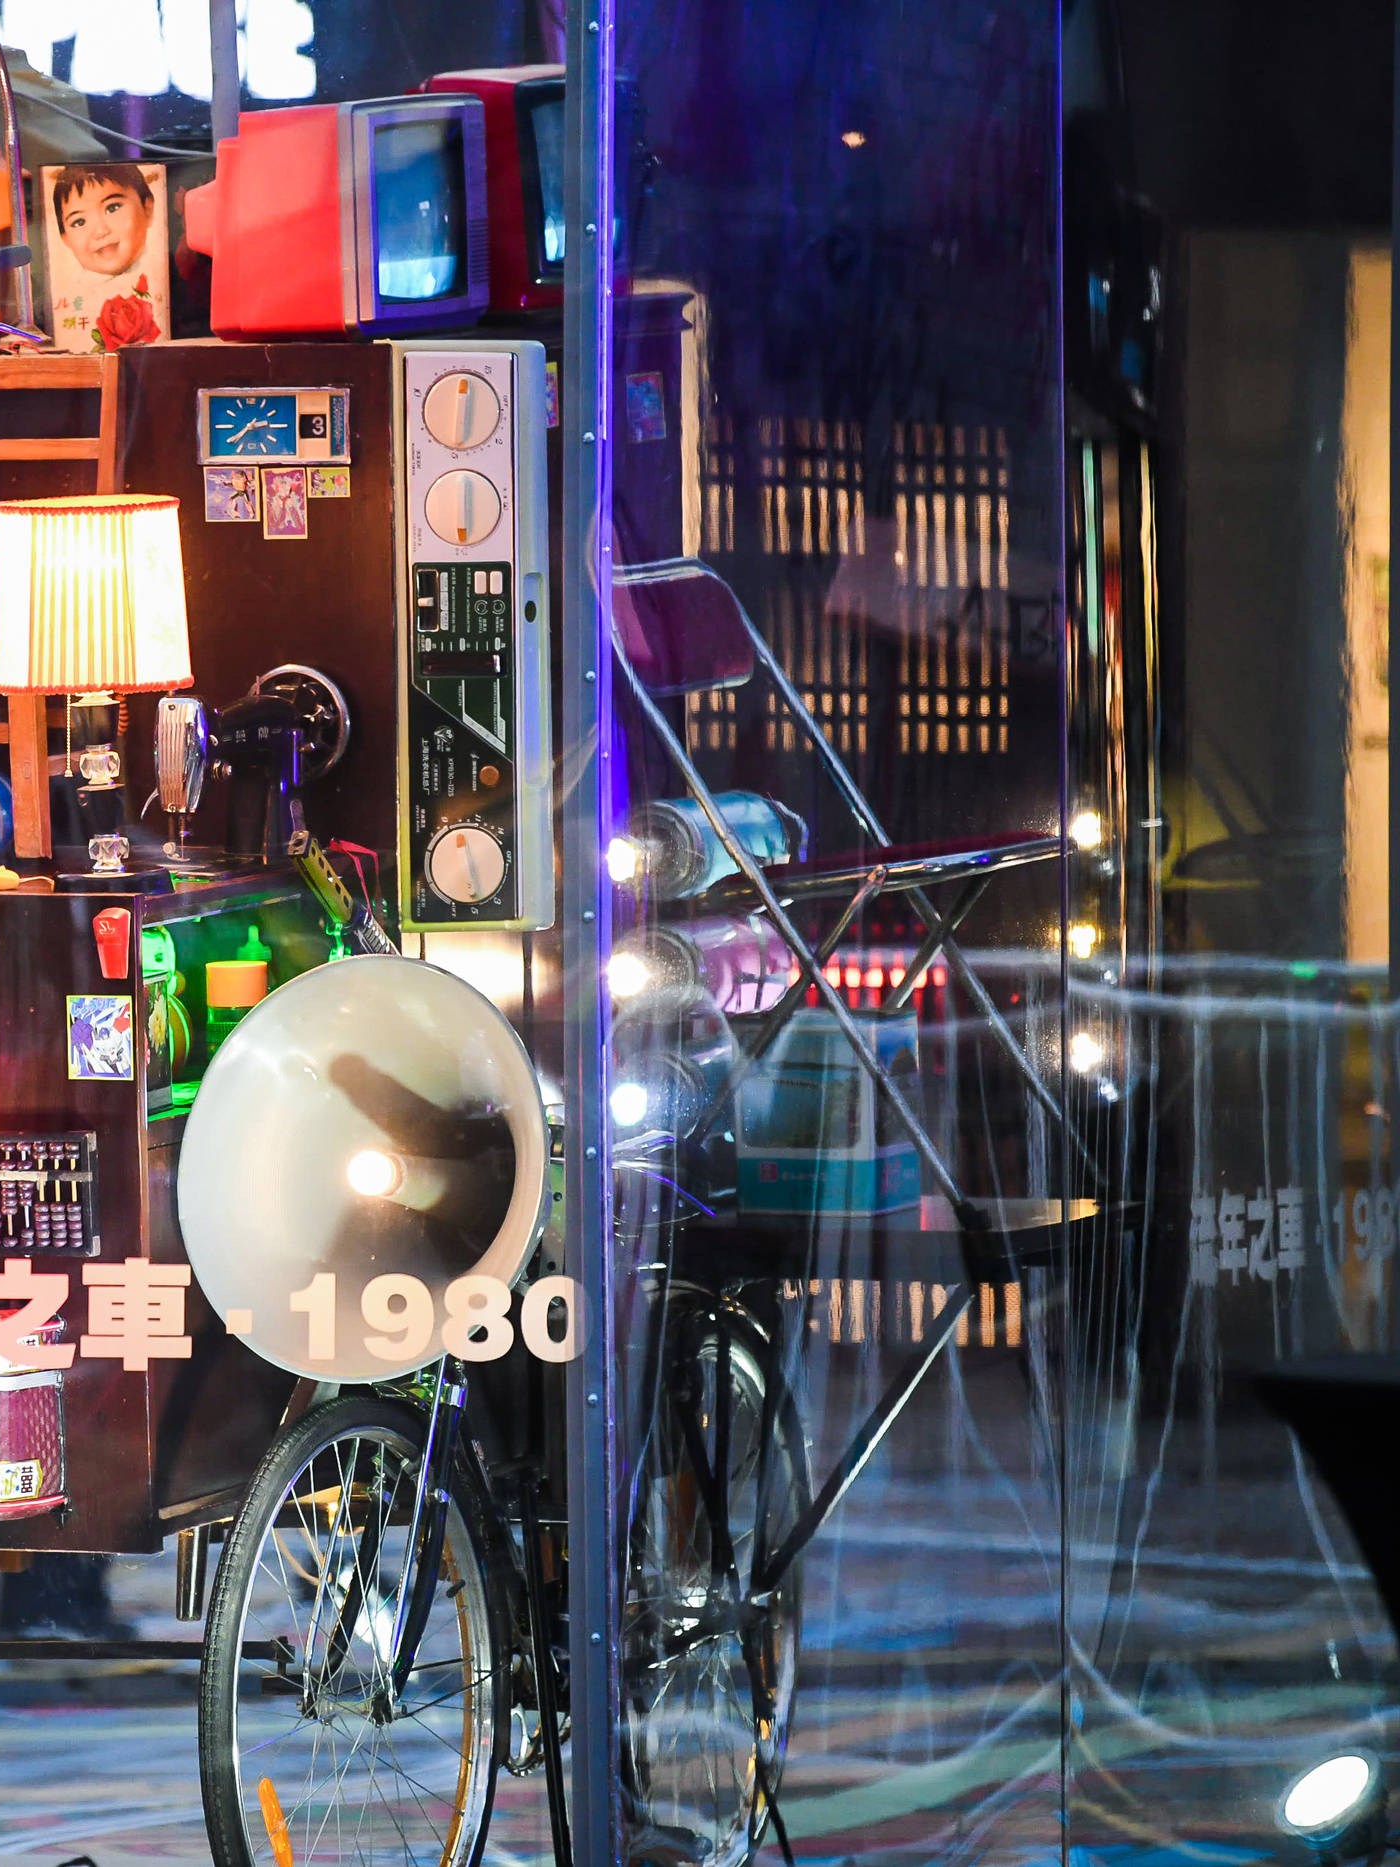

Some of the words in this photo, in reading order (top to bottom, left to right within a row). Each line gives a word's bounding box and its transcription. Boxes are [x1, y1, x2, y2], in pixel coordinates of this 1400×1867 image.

[312, 416, 324, 436] 3
[1333, 1187, 1399, 1262] 198
[290, 1272, 588, 1364] 1980
